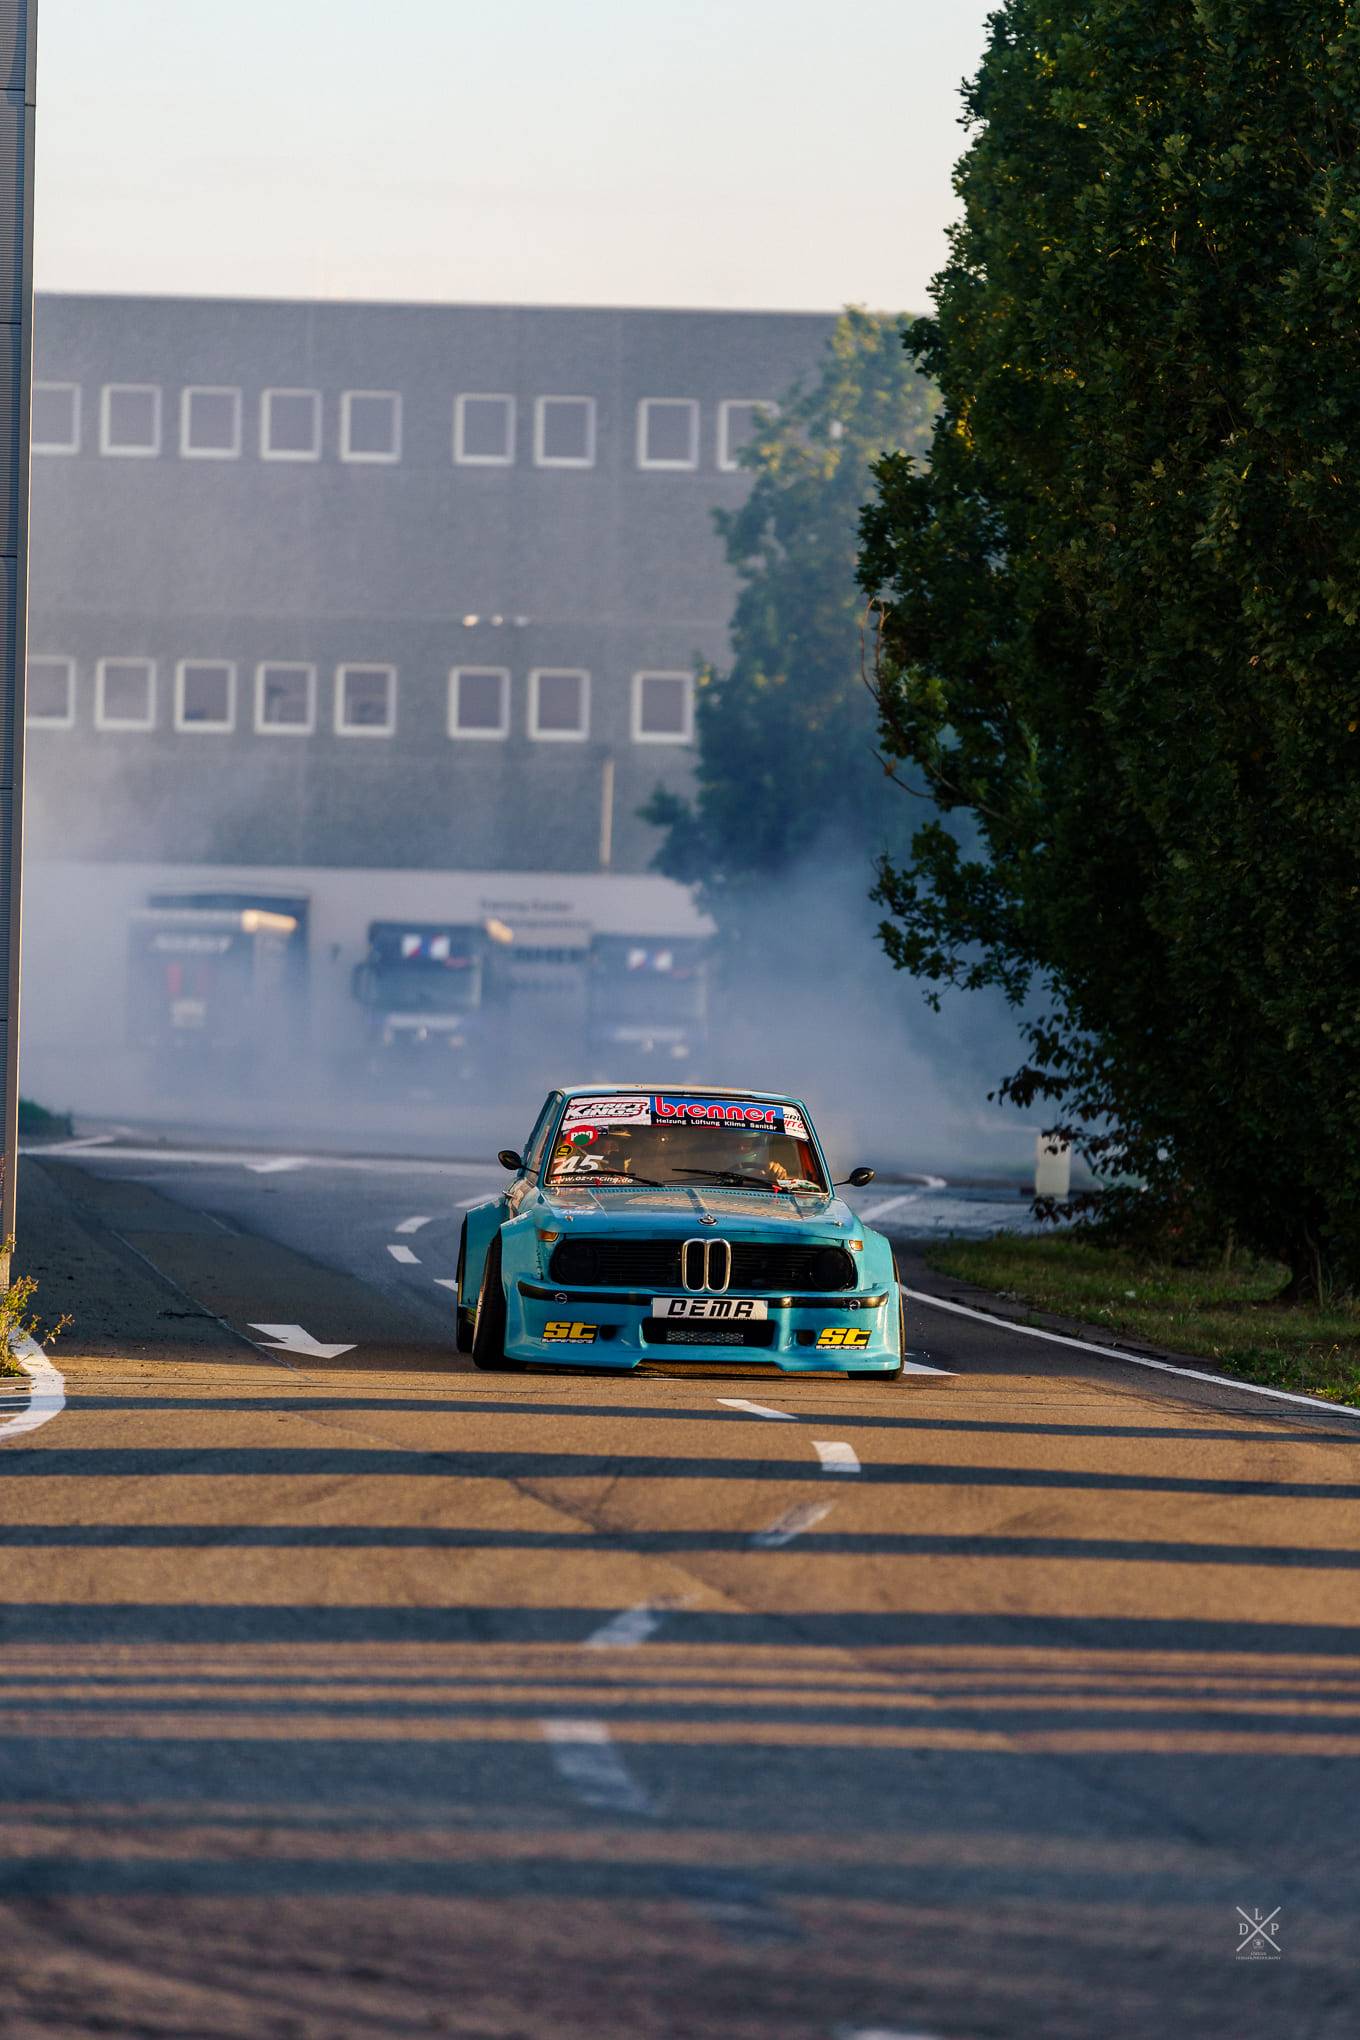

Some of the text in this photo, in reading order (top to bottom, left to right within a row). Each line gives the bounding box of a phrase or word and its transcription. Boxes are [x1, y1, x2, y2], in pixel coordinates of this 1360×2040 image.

[655, 1097, 775, 1124] brenner
[691, 1119, 720, 1127] Lüftung
[750, 1123, 777, 1131] Sanitär
[553, 1154, 604, 1174] 45
[668, 1299, 754, 1318] DEMA
